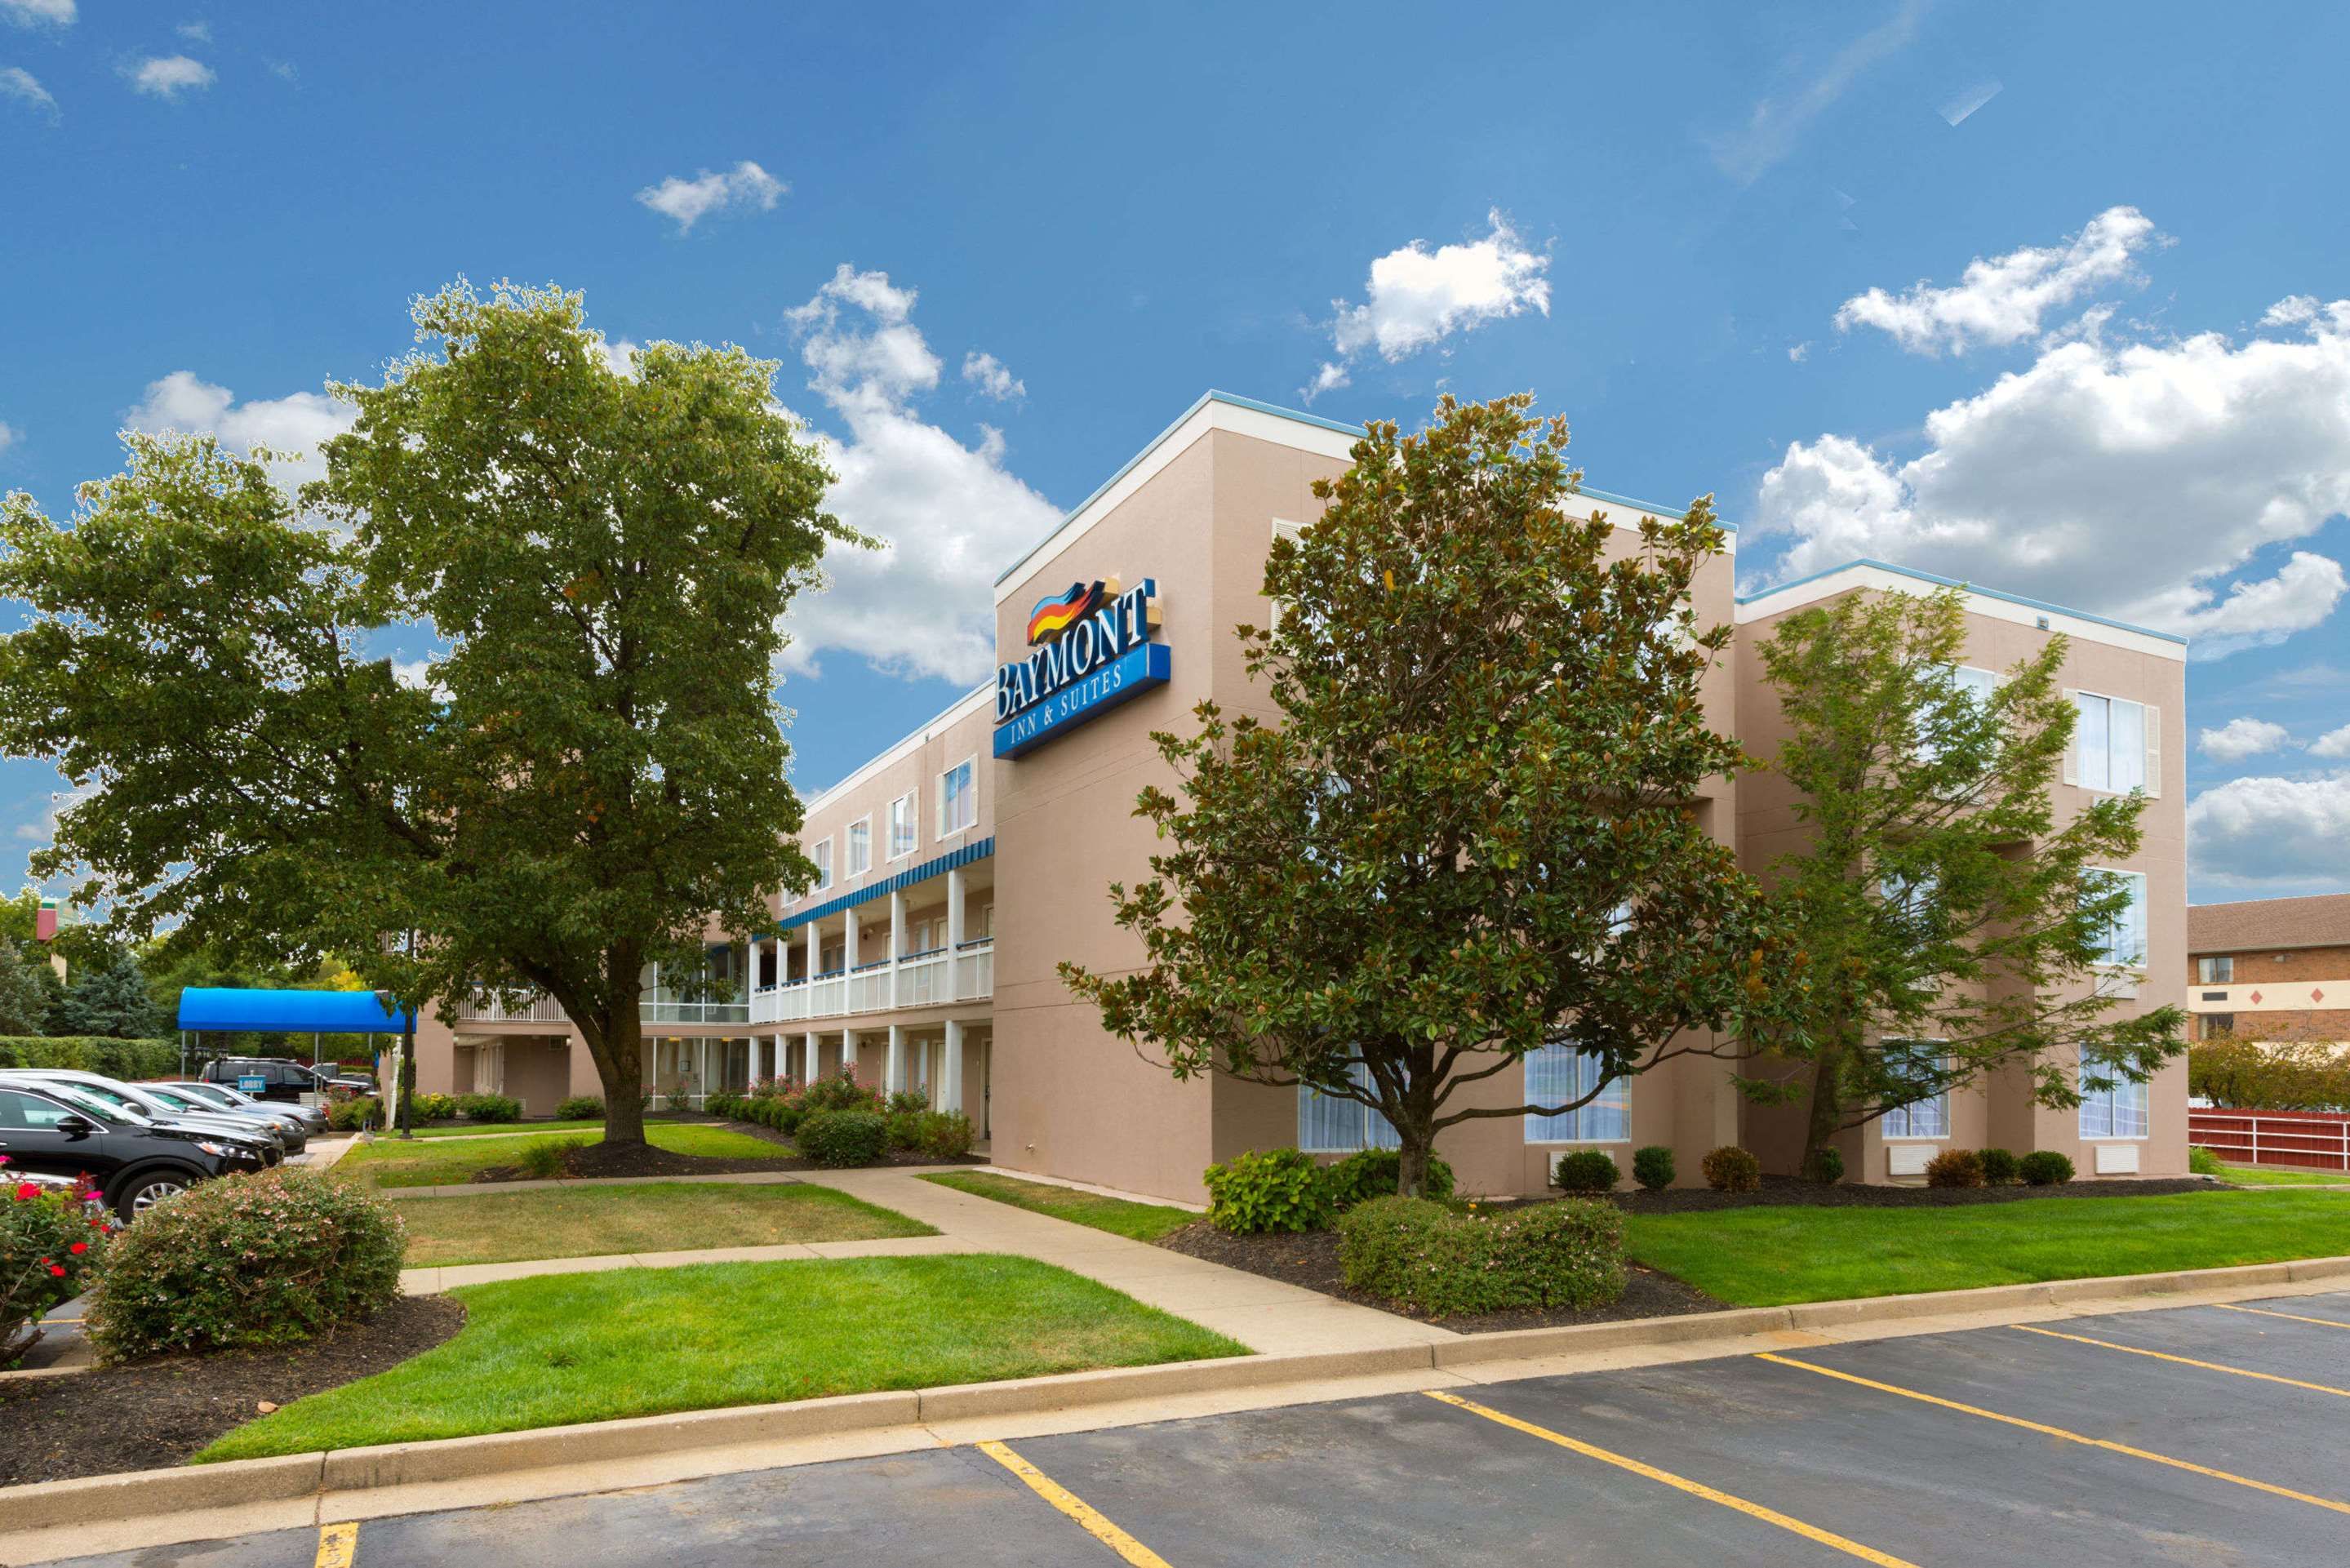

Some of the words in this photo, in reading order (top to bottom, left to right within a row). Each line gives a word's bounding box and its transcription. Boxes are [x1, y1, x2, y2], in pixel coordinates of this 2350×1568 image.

[993, 579, 1148, 723] BAYMONT
[1011, 713, 1037, 744] INN
[1044, 704, 1054, 726] &
[1061, 664, 1122, 716] SUITES
[239, 1079, 264, 1089] LOBBY
